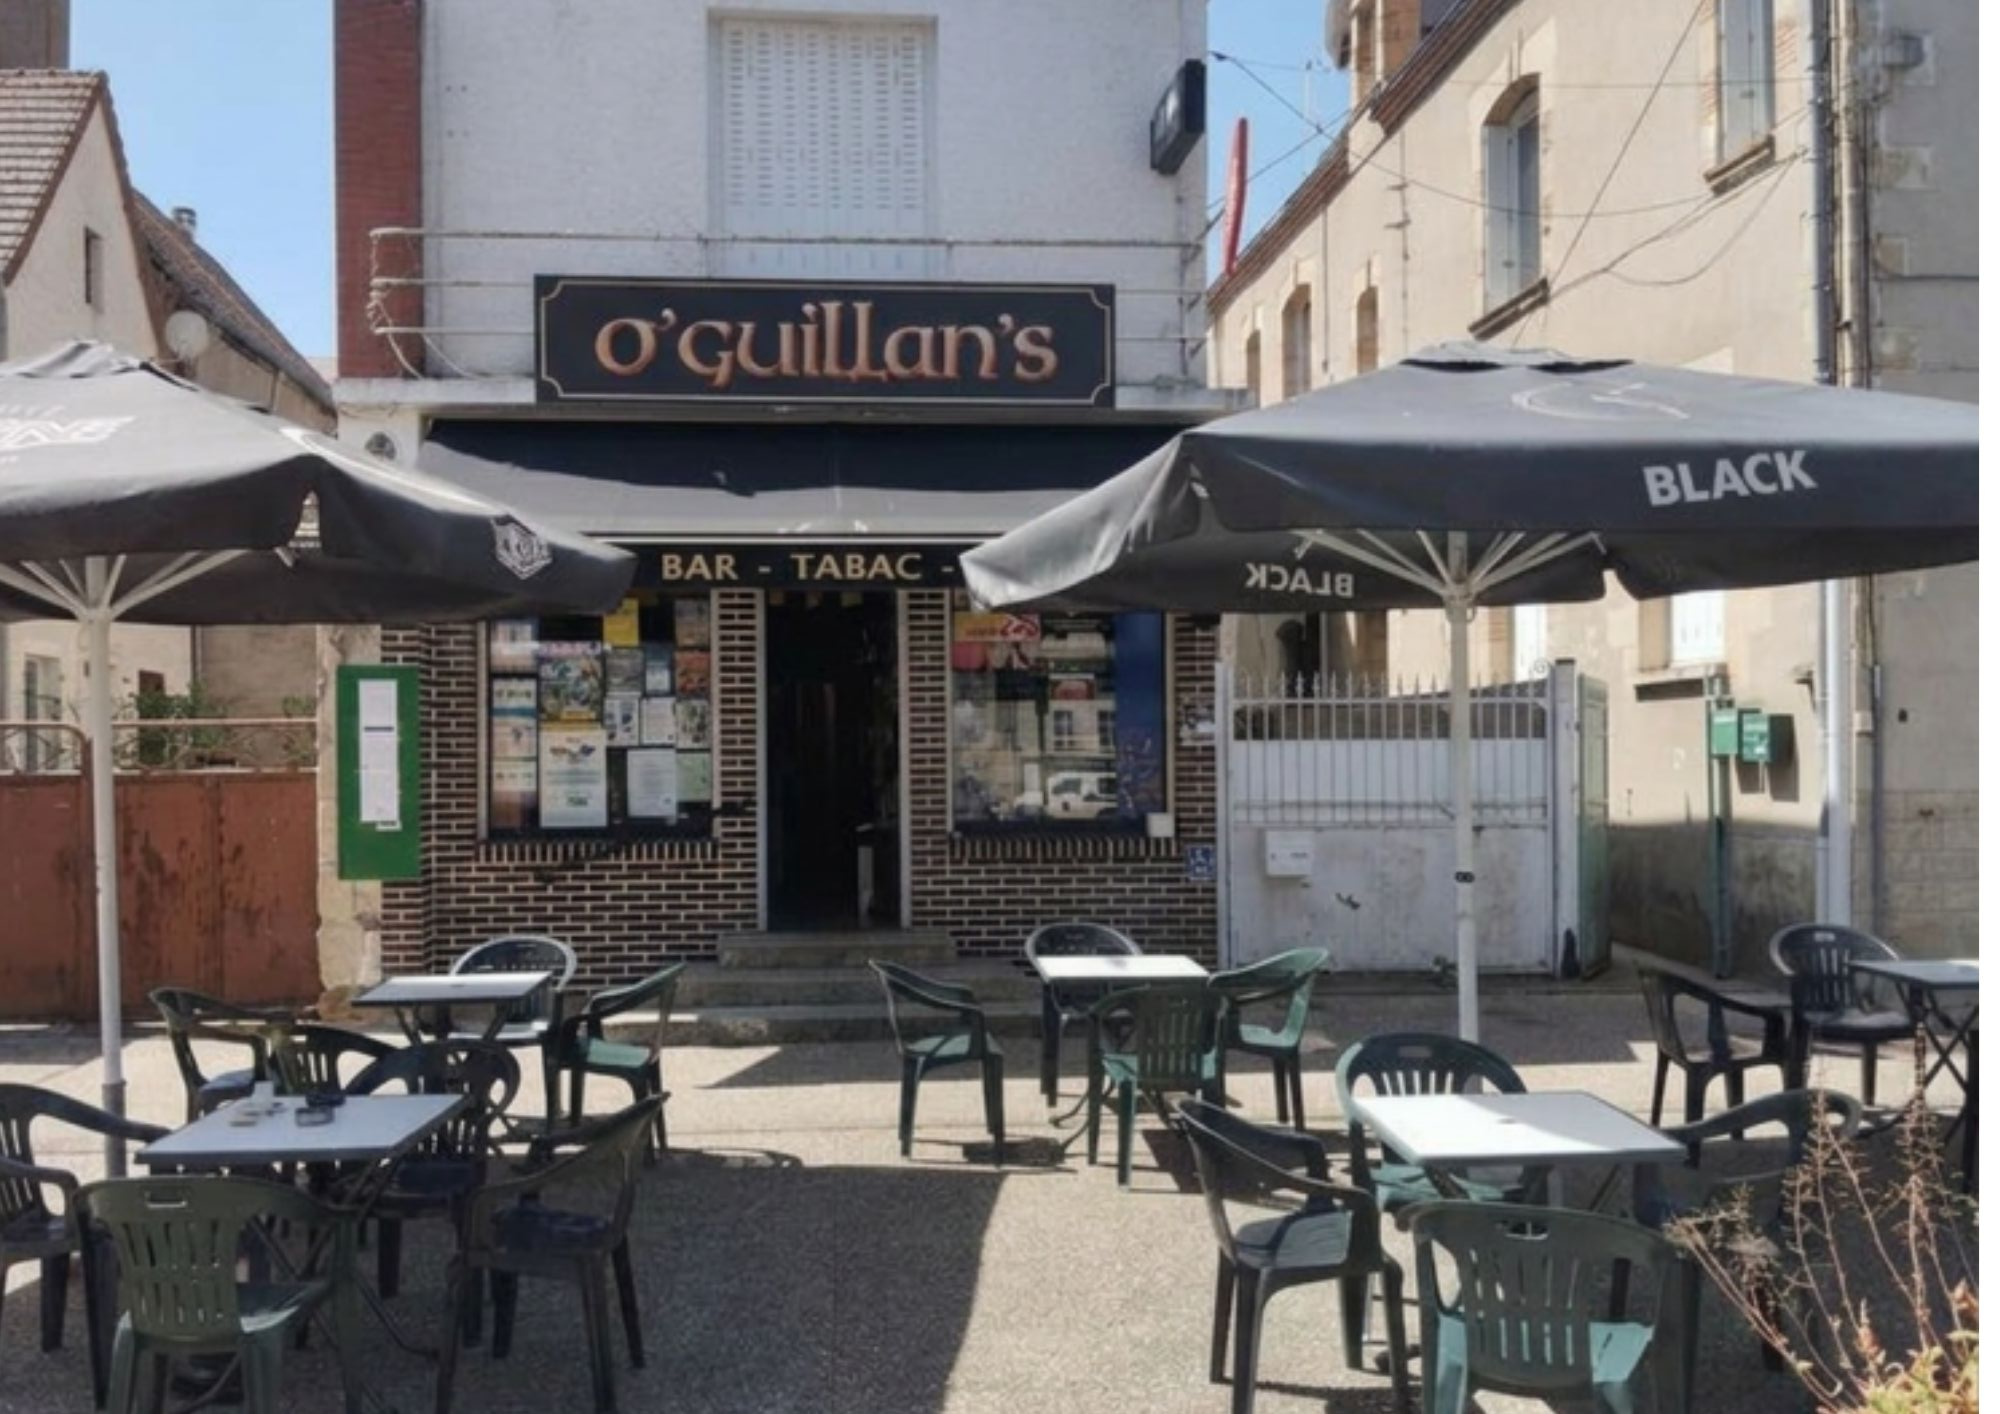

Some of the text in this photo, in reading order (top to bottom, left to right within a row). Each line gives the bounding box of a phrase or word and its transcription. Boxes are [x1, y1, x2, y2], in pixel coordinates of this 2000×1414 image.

[1643, 450, 1819, 507] BLACK
[661, 553, 739, 580] BAR
[790, 553, 923, 580] TABAC
